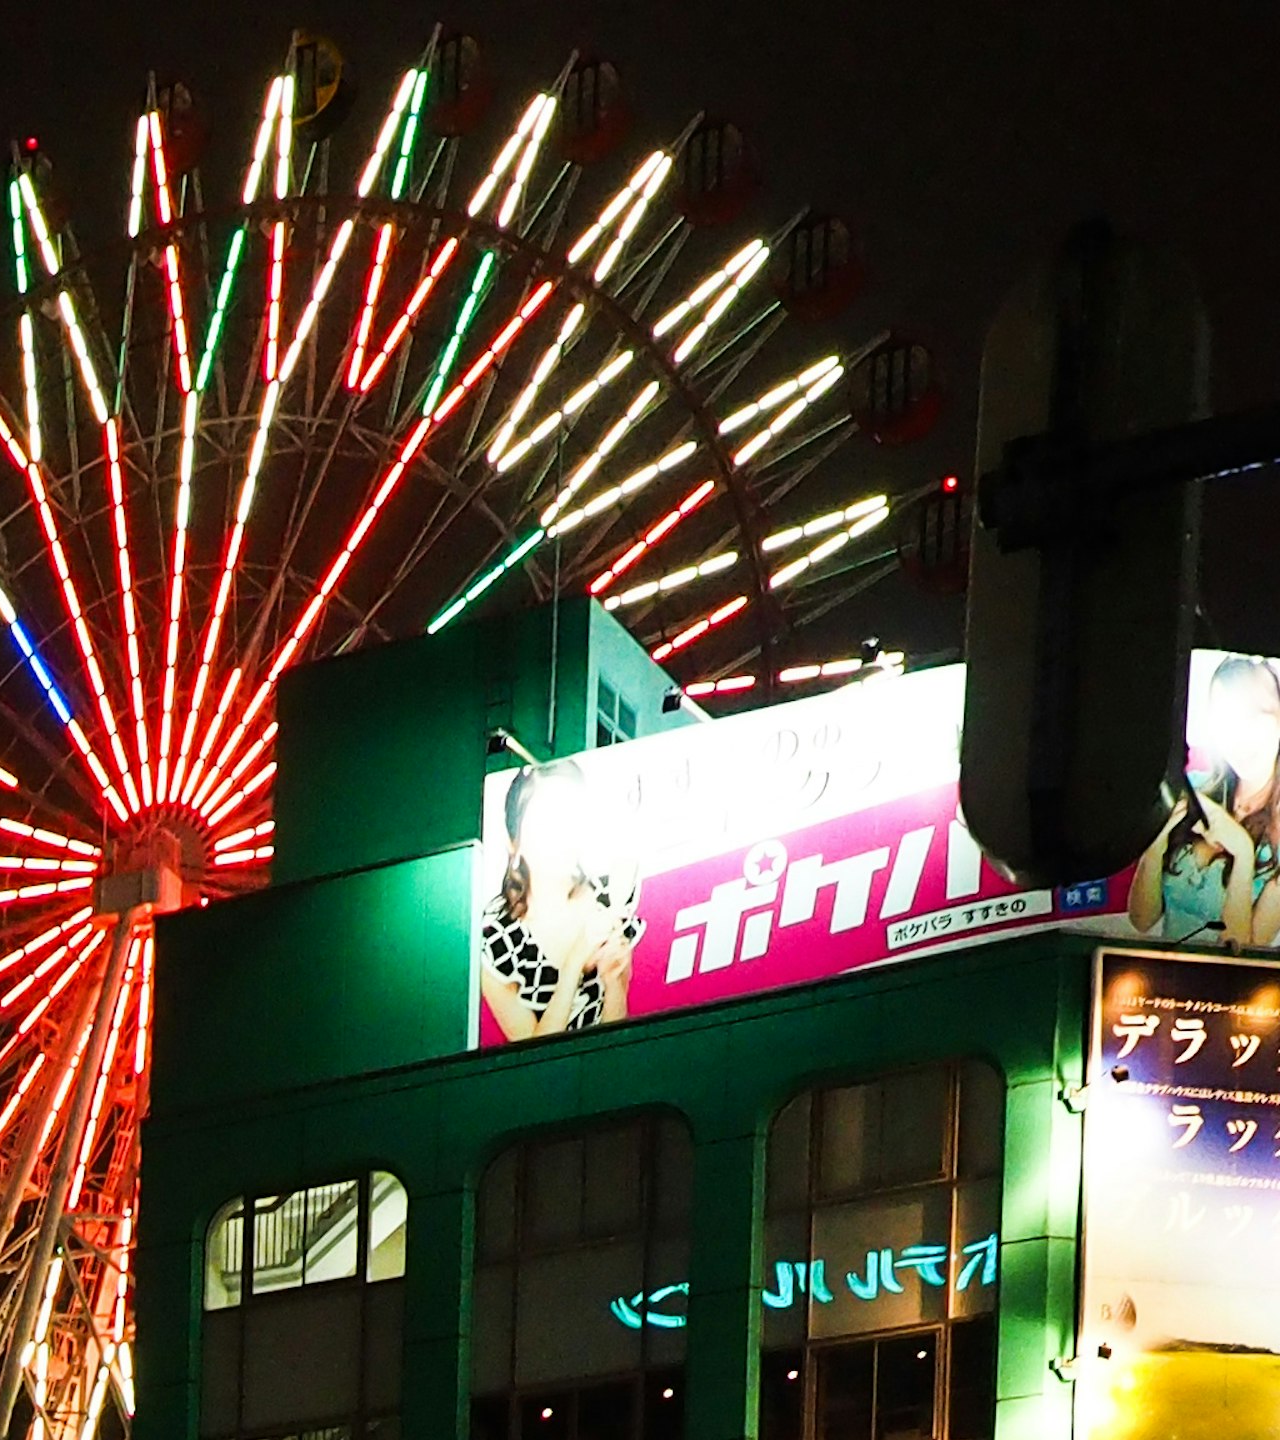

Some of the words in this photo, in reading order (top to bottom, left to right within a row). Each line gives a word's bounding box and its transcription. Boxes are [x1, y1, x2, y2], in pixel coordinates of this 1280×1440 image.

[665, 822, 982, 984] ポケパ
[894, 914, 953, 942] ポケパラ
[962, 898, 1027, 924] すすきの
[1112, 1013, 1280, 1072] デラッ
[1166, 1104, 1280, 1158] ラッ
